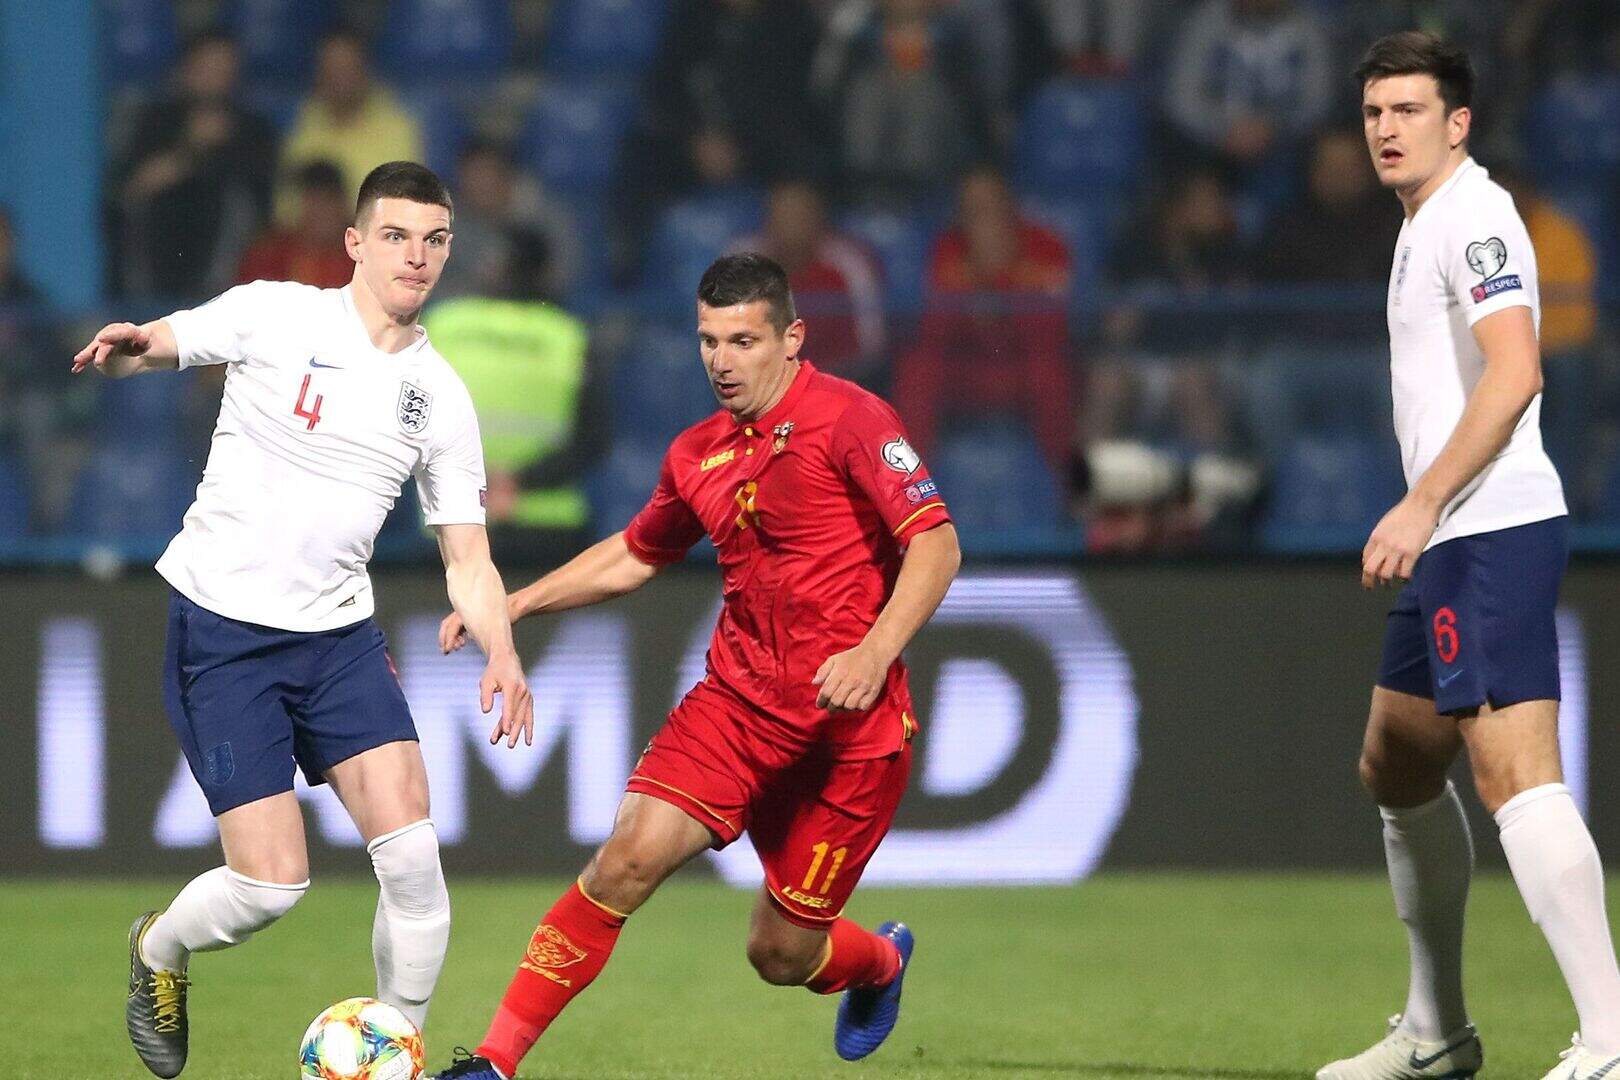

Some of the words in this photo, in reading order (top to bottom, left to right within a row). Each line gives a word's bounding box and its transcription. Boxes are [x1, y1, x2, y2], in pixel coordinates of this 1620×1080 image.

[1484, 278, 1521, 293] RESPECT
[293, 373, 323, 431] 4
[1433, 606, 1460, 663] 6
[36, 617, 105, 848] I
[801, 841, 847, 895] 11
